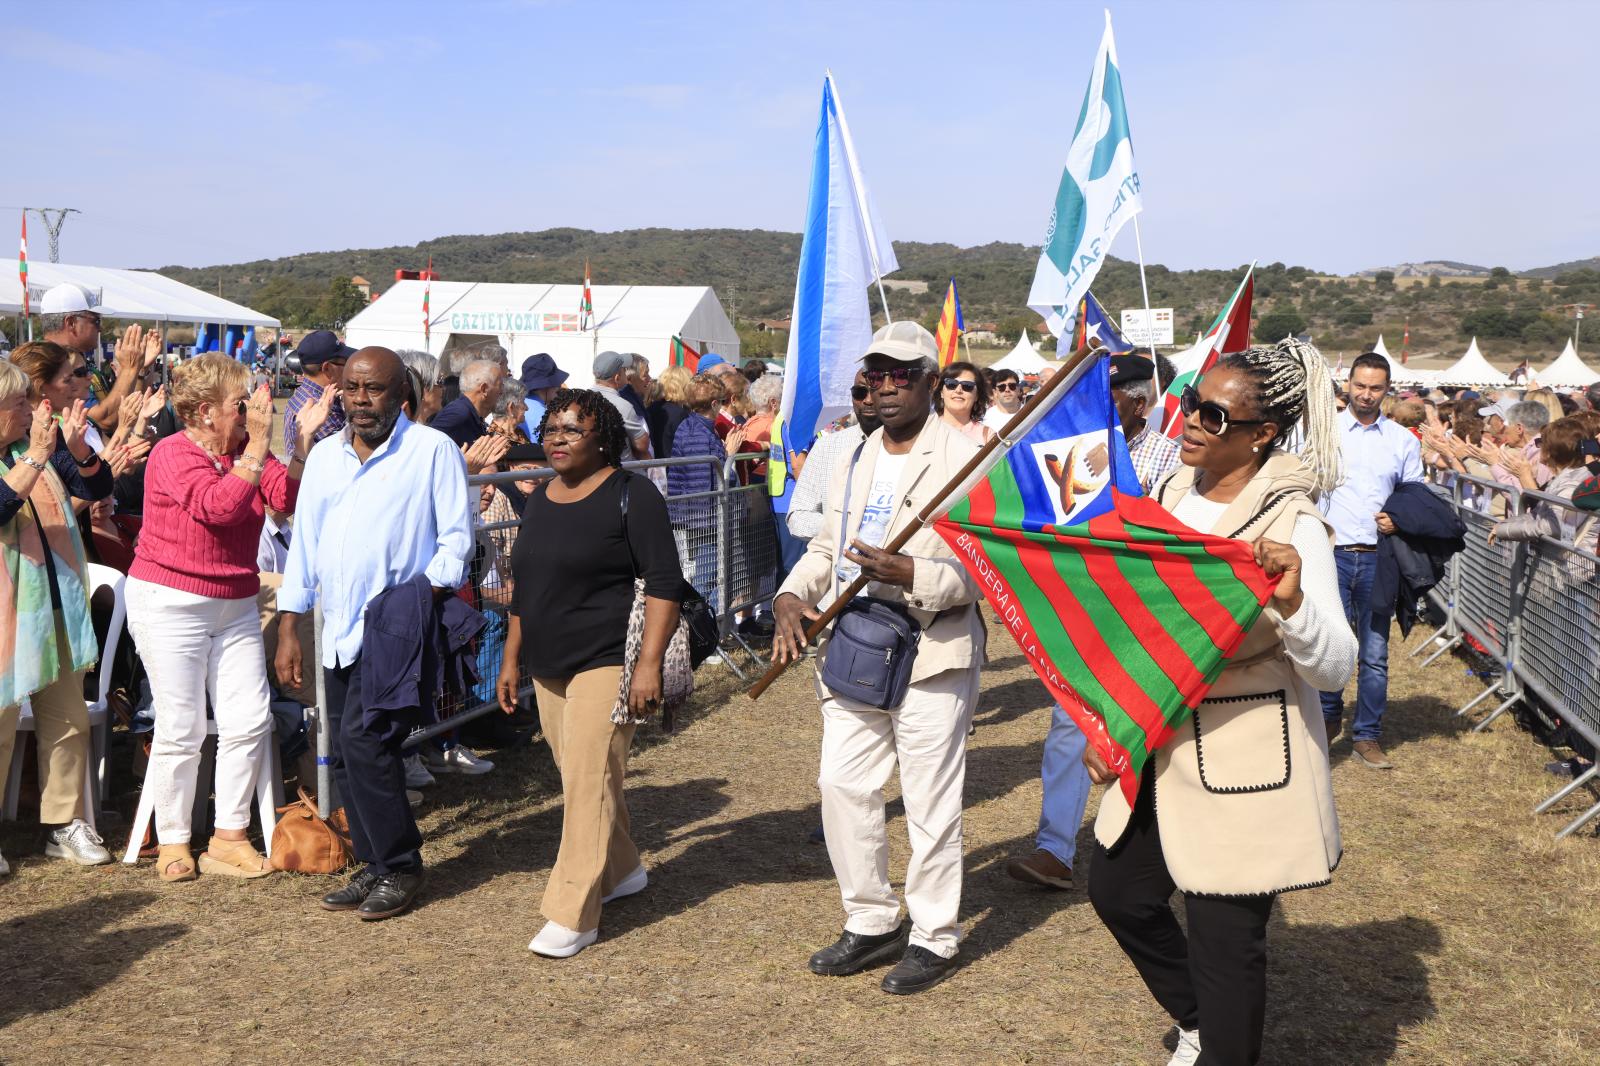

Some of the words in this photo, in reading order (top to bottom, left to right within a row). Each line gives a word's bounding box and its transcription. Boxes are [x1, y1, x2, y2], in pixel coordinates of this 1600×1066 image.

[451, 313, 541, 331] GAZTETXOAK
[956, 532, 1009, 609] BANDERA
[1004, 604, 1023, 635] DE
[1021, 631, 1037, 657] LA
